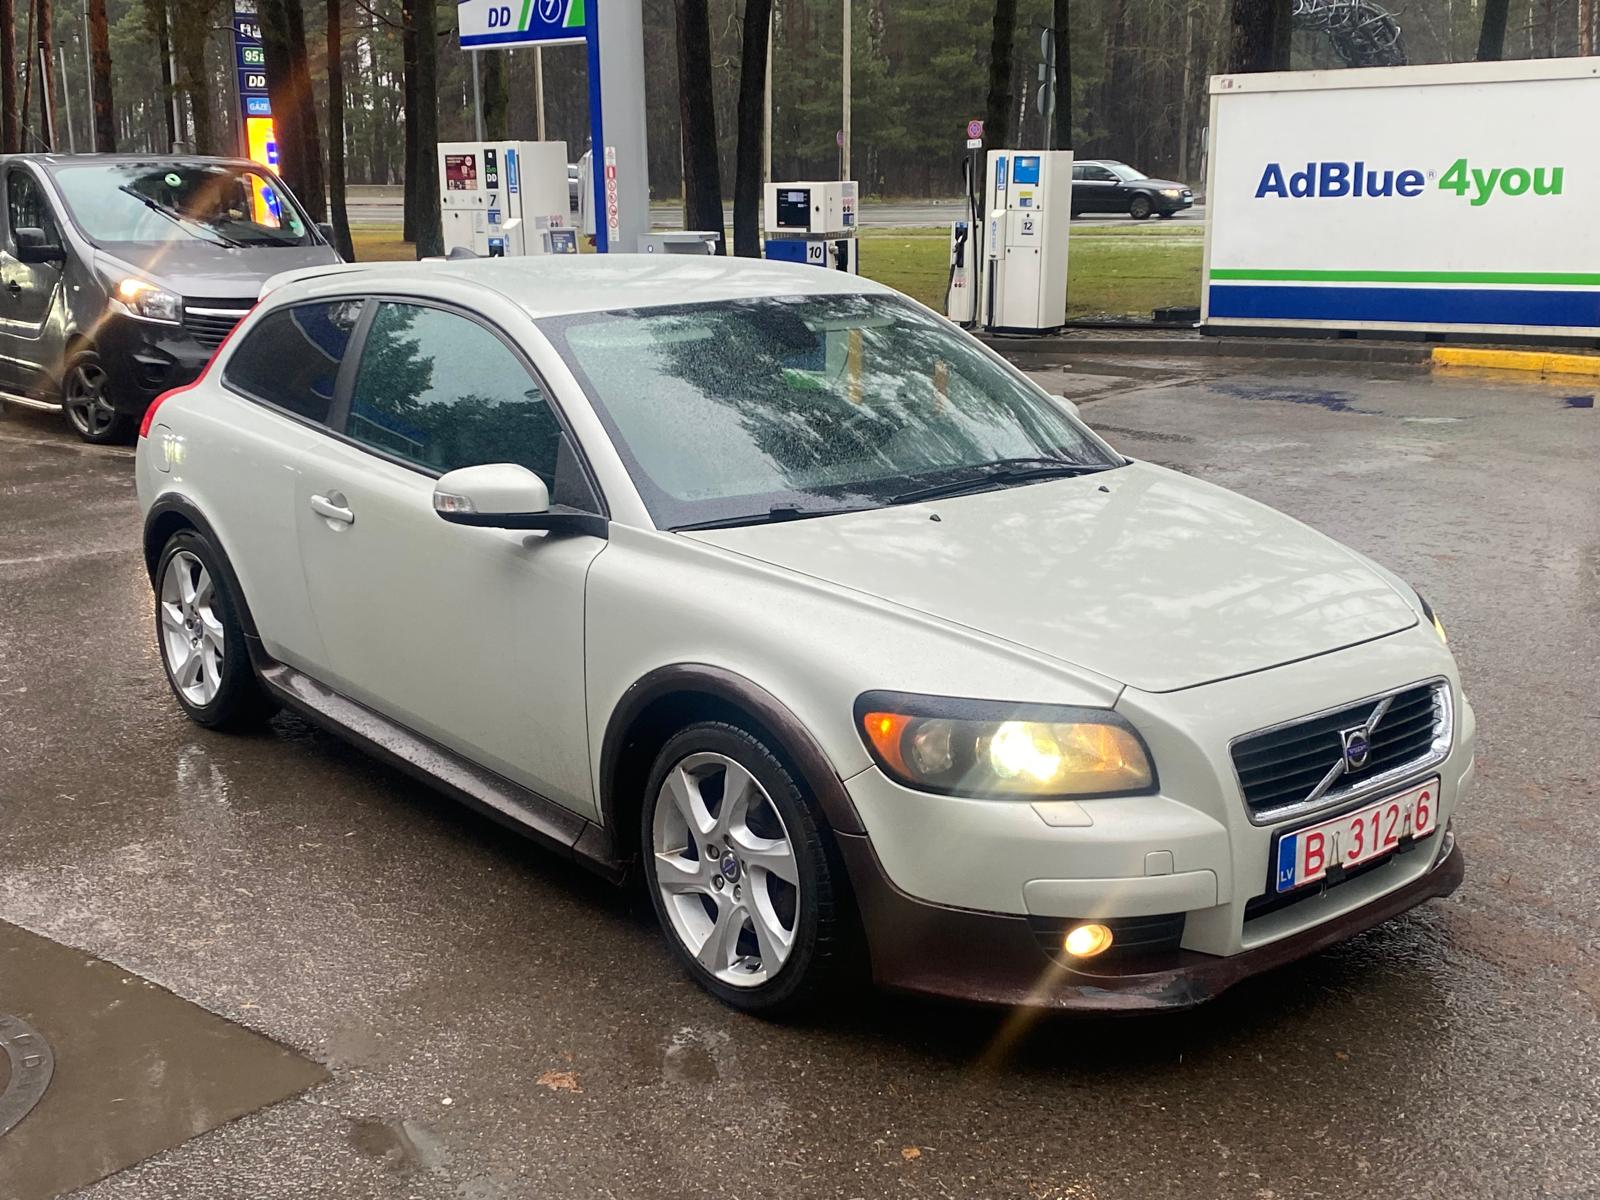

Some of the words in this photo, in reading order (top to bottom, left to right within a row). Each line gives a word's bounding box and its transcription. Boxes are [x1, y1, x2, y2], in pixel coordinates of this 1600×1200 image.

[545, 0, 555, 16] 7
[488, 6, 511, 28] DD
[248, 75, 266, 87] DD
[1437, 157, 1565, 207] 4you
[489, 194, 497, 207] 7
[1023, 221, 1033, 231] 12
[808, 246, 822, 259] 10
[1303, 832, 1326, 878] B
[1280, 867, 1294, 883] LV
